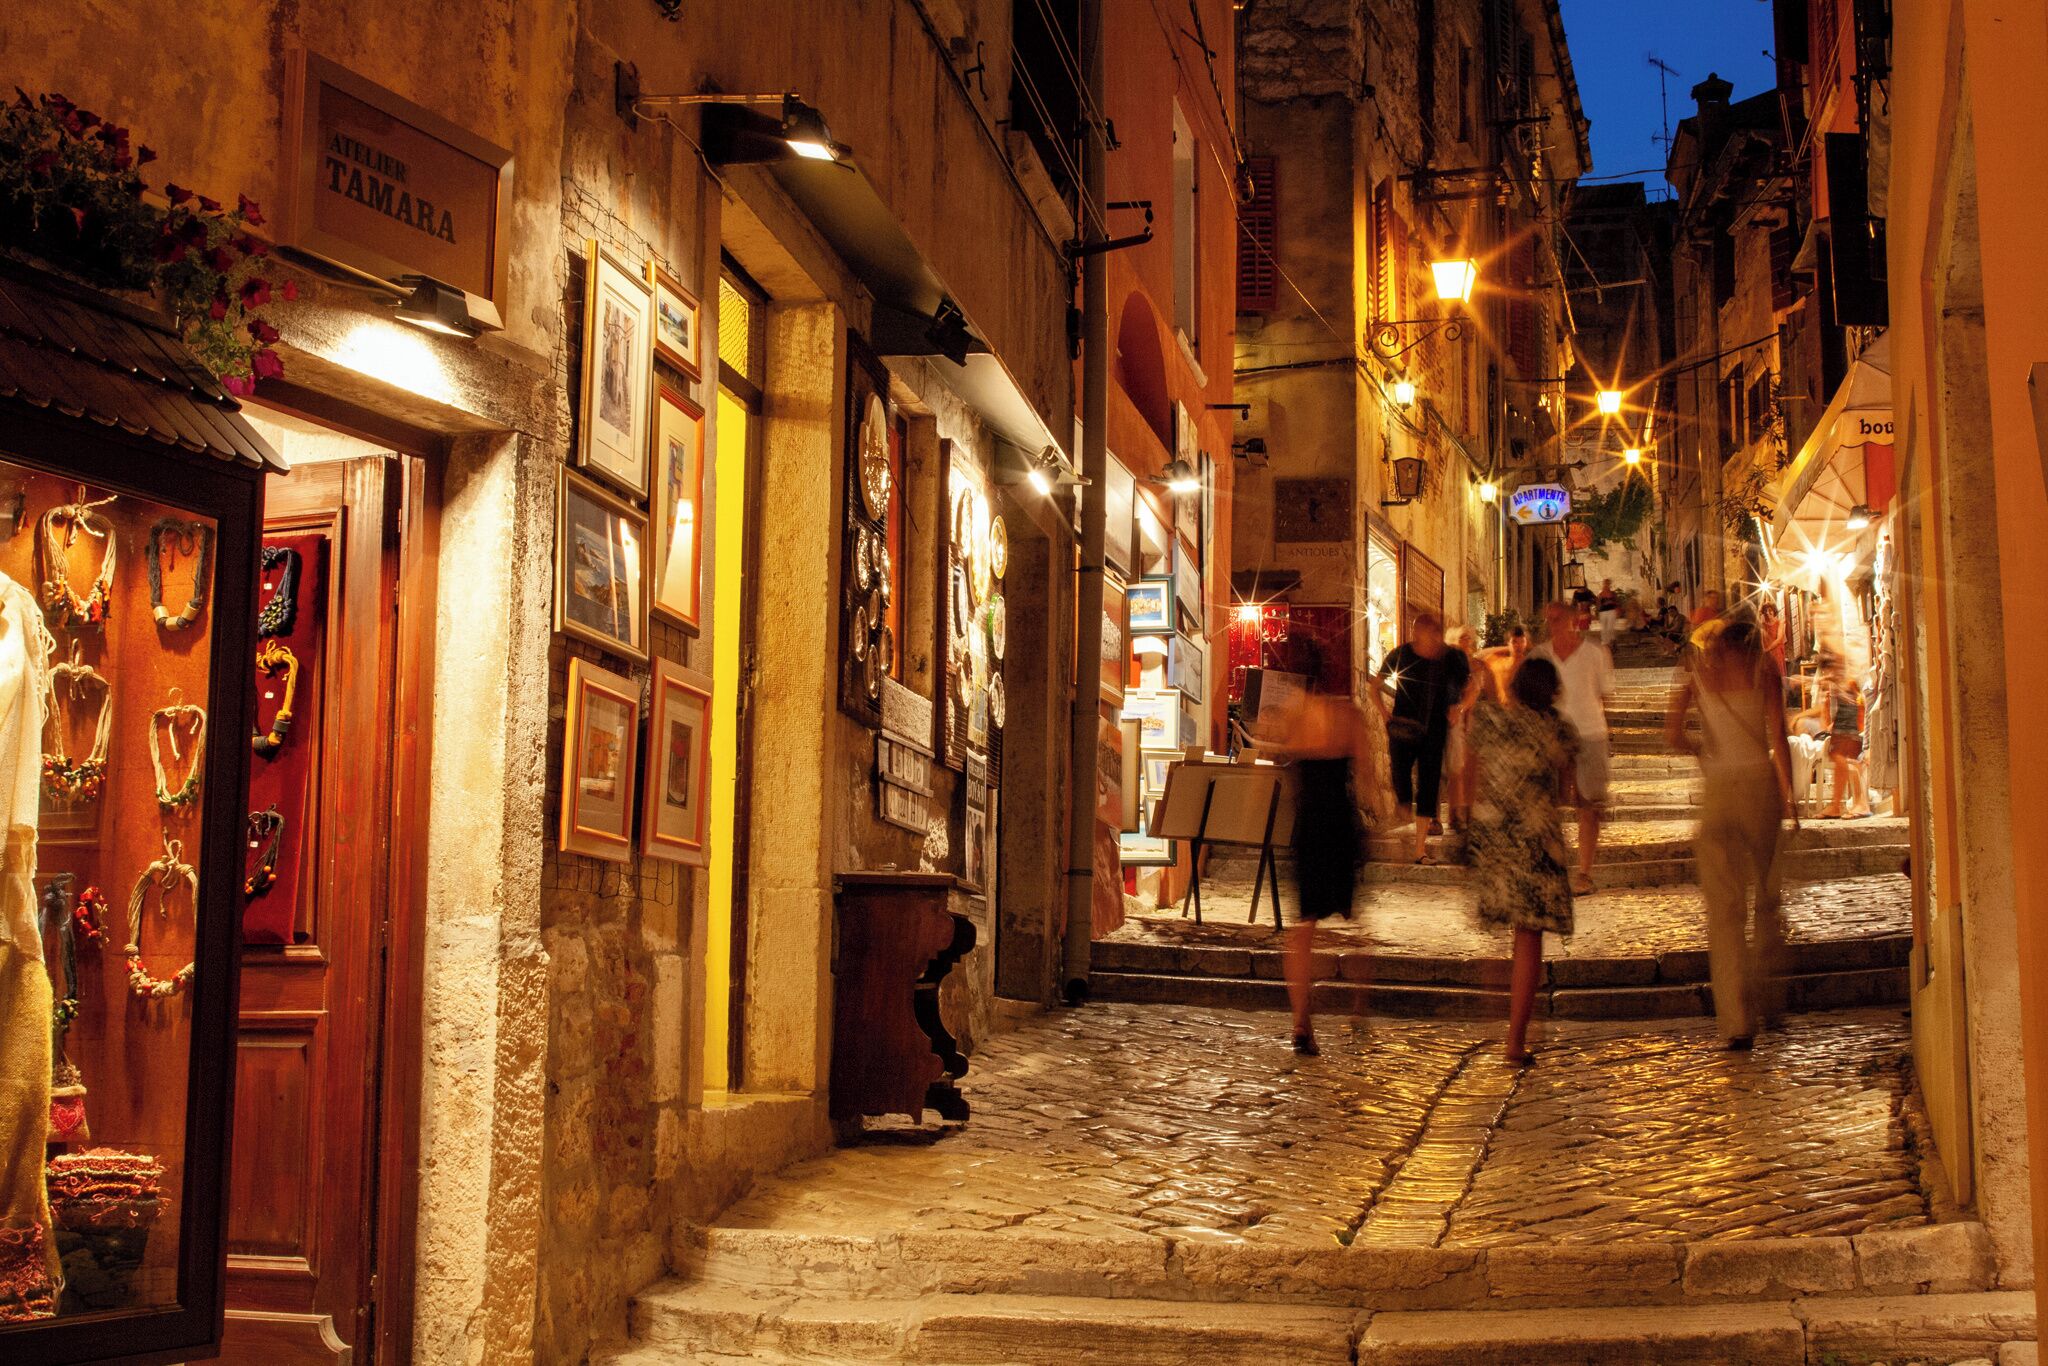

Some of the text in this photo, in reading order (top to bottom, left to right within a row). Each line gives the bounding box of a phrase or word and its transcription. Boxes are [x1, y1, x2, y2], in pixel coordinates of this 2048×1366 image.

[329, 131, 407, 184] ATELIER
[325, 156, 457, 245] TAMARA
[1512, 488, 1567, 506] APARTMENTS
[1288, 546, 1341, 557] ANTIQUES
